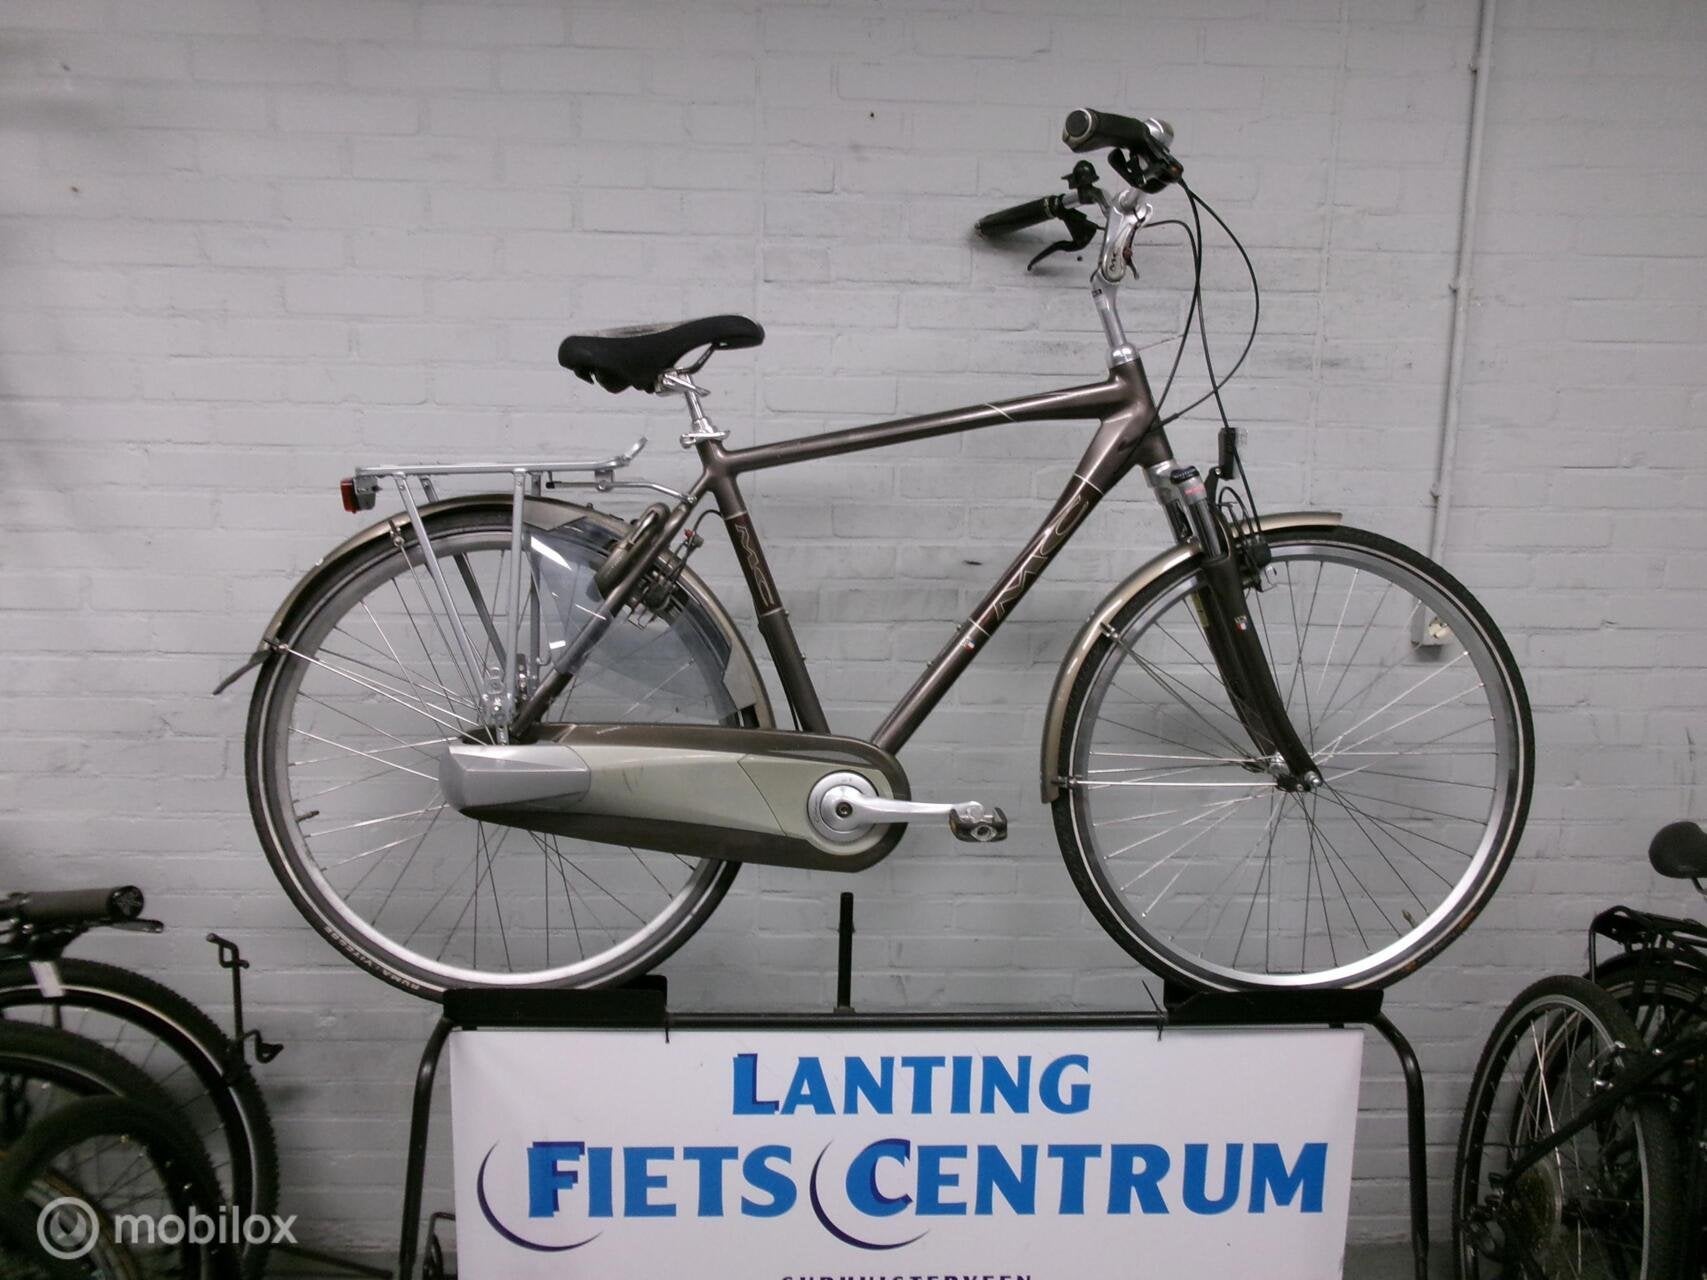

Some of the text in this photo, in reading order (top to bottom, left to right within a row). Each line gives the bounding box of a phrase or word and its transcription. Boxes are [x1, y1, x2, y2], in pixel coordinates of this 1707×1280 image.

[733, 1053, 1091, 1115] LANTING
[527, 1138, 1328, 1217] FIETS CENTRUM
